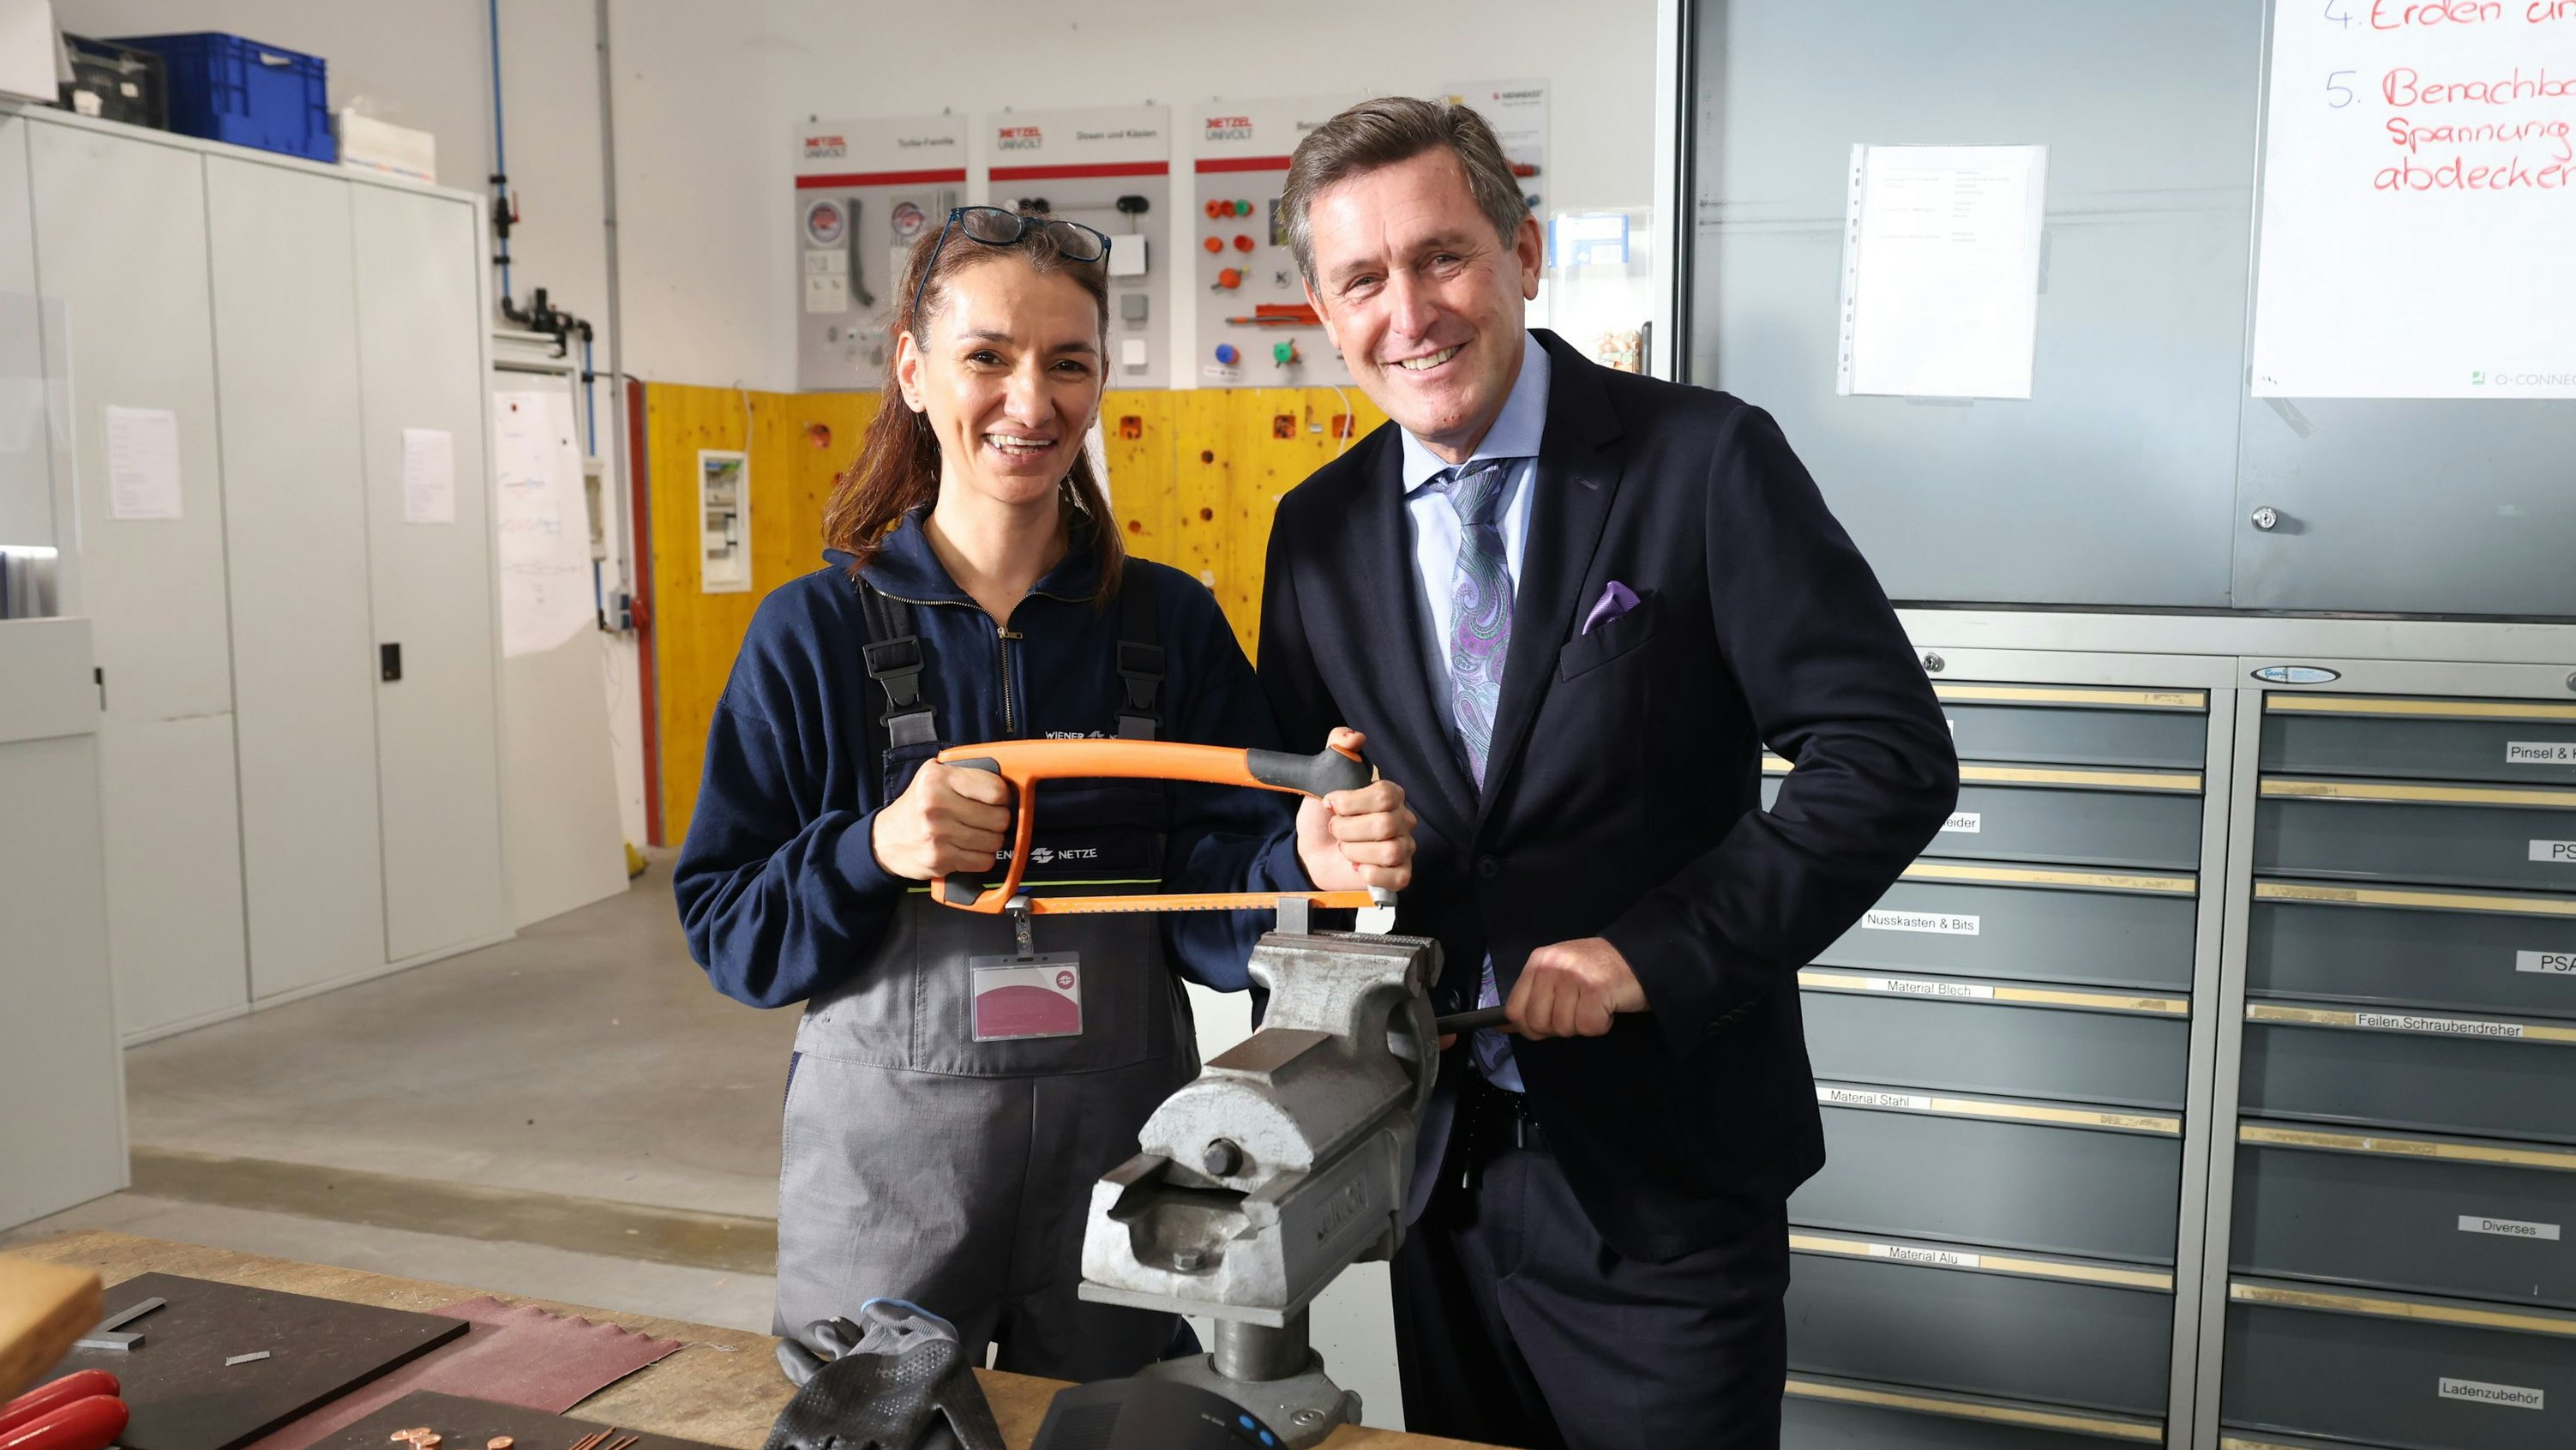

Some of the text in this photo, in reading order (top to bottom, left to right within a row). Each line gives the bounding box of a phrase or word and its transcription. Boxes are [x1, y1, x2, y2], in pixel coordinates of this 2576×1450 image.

[2371, 0, 2501, 30] Erden
[1205, 129, 1252, 140] UNIVOLT
[2387, 117, 2573, 162] Spannung
[1045, 731, 1084, 740] WIENER
[2511, 746, 2552, 759] Pinsel
[2557, 747, 2567, 760] &
[1943, 816, 1977, 828] eider
[1058, 848, 1098, 860] NETZE
[1867, 913, 1974, 931] Nusskasten & Bits
[1888, 980, 1972, 996] Material Blech
[1830, 1090, 1910, 1107] Material Stahl
[2483, 1219, 2537, 1236] Diverses
[1889, 1247, 1958, 1265] Material Alu
[2442, 1381, 2540, 1405] Ladenzubehör
